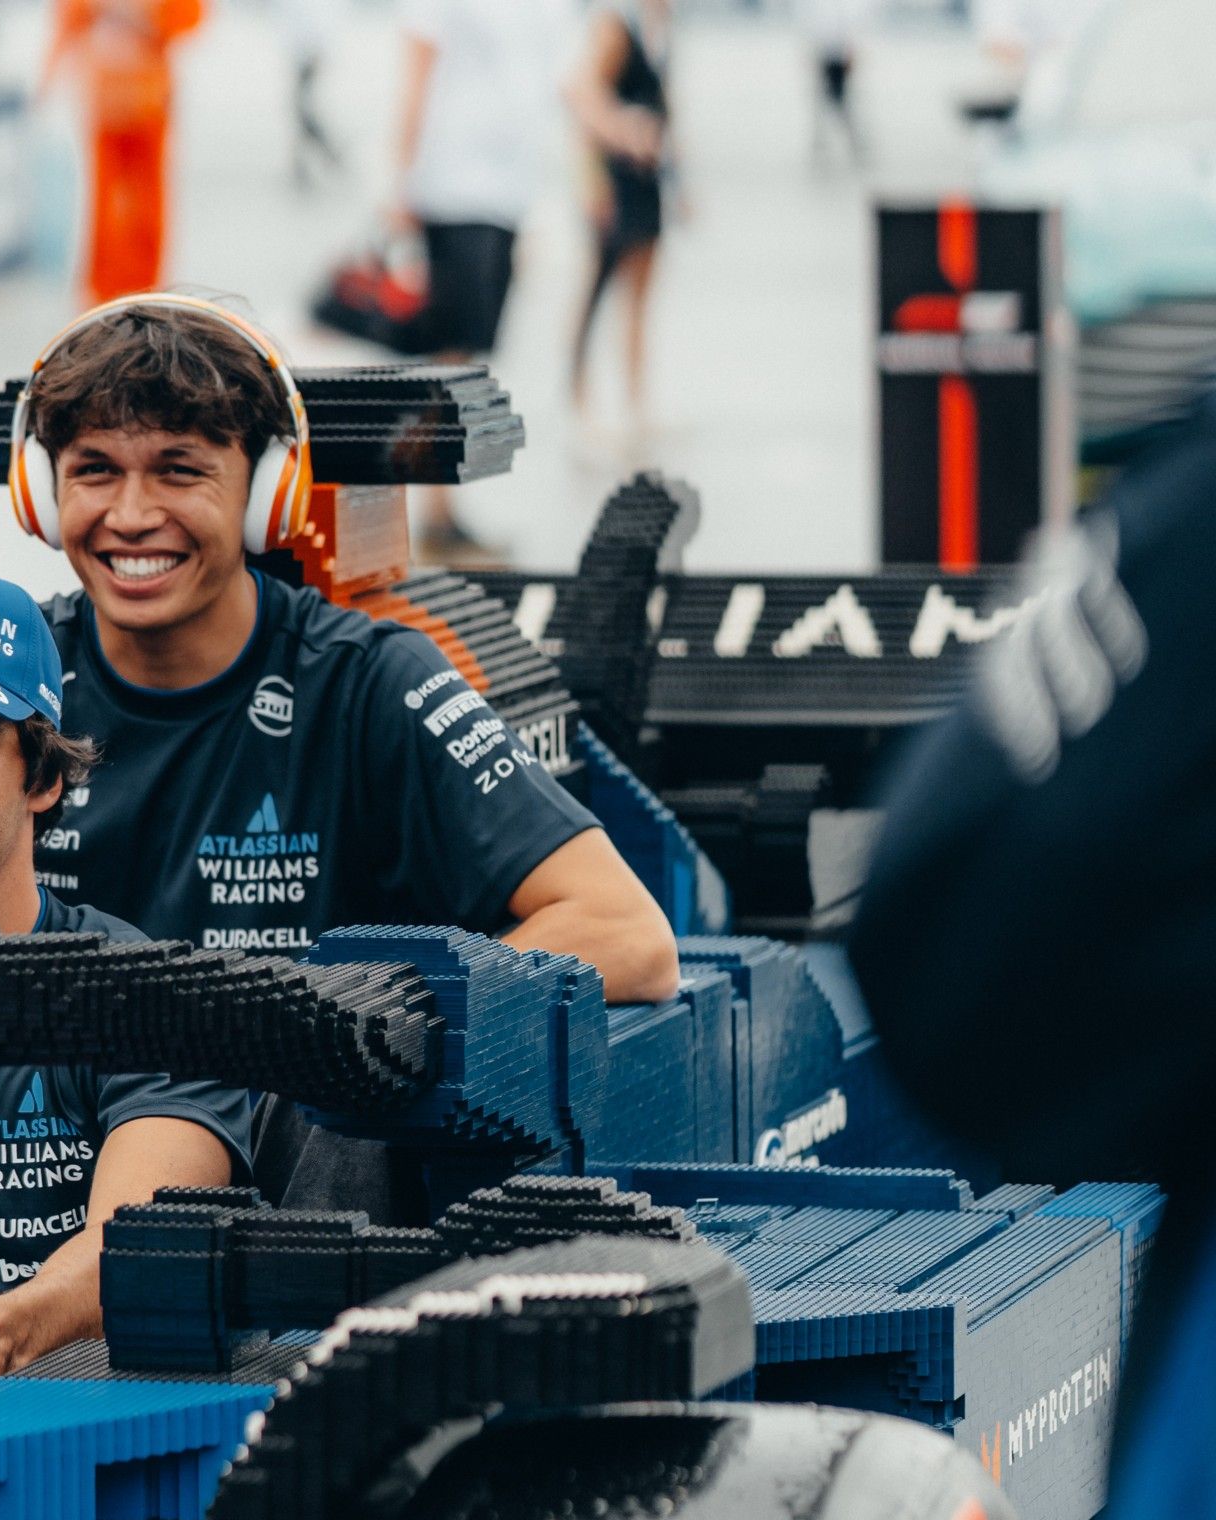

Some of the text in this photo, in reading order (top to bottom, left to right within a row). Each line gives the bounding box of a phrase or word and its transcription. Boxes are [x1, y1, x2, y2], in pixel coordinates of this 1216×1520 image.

[198, 832, 319, 857] ATLASSIAN
[197, 856, 320, 881] WILLIAMS
[210, 881, 306, 905] RACING
[202, 926, 313, 950] DURACELL
[1008, 1347, 1111, 1467] MYPROTEIN
